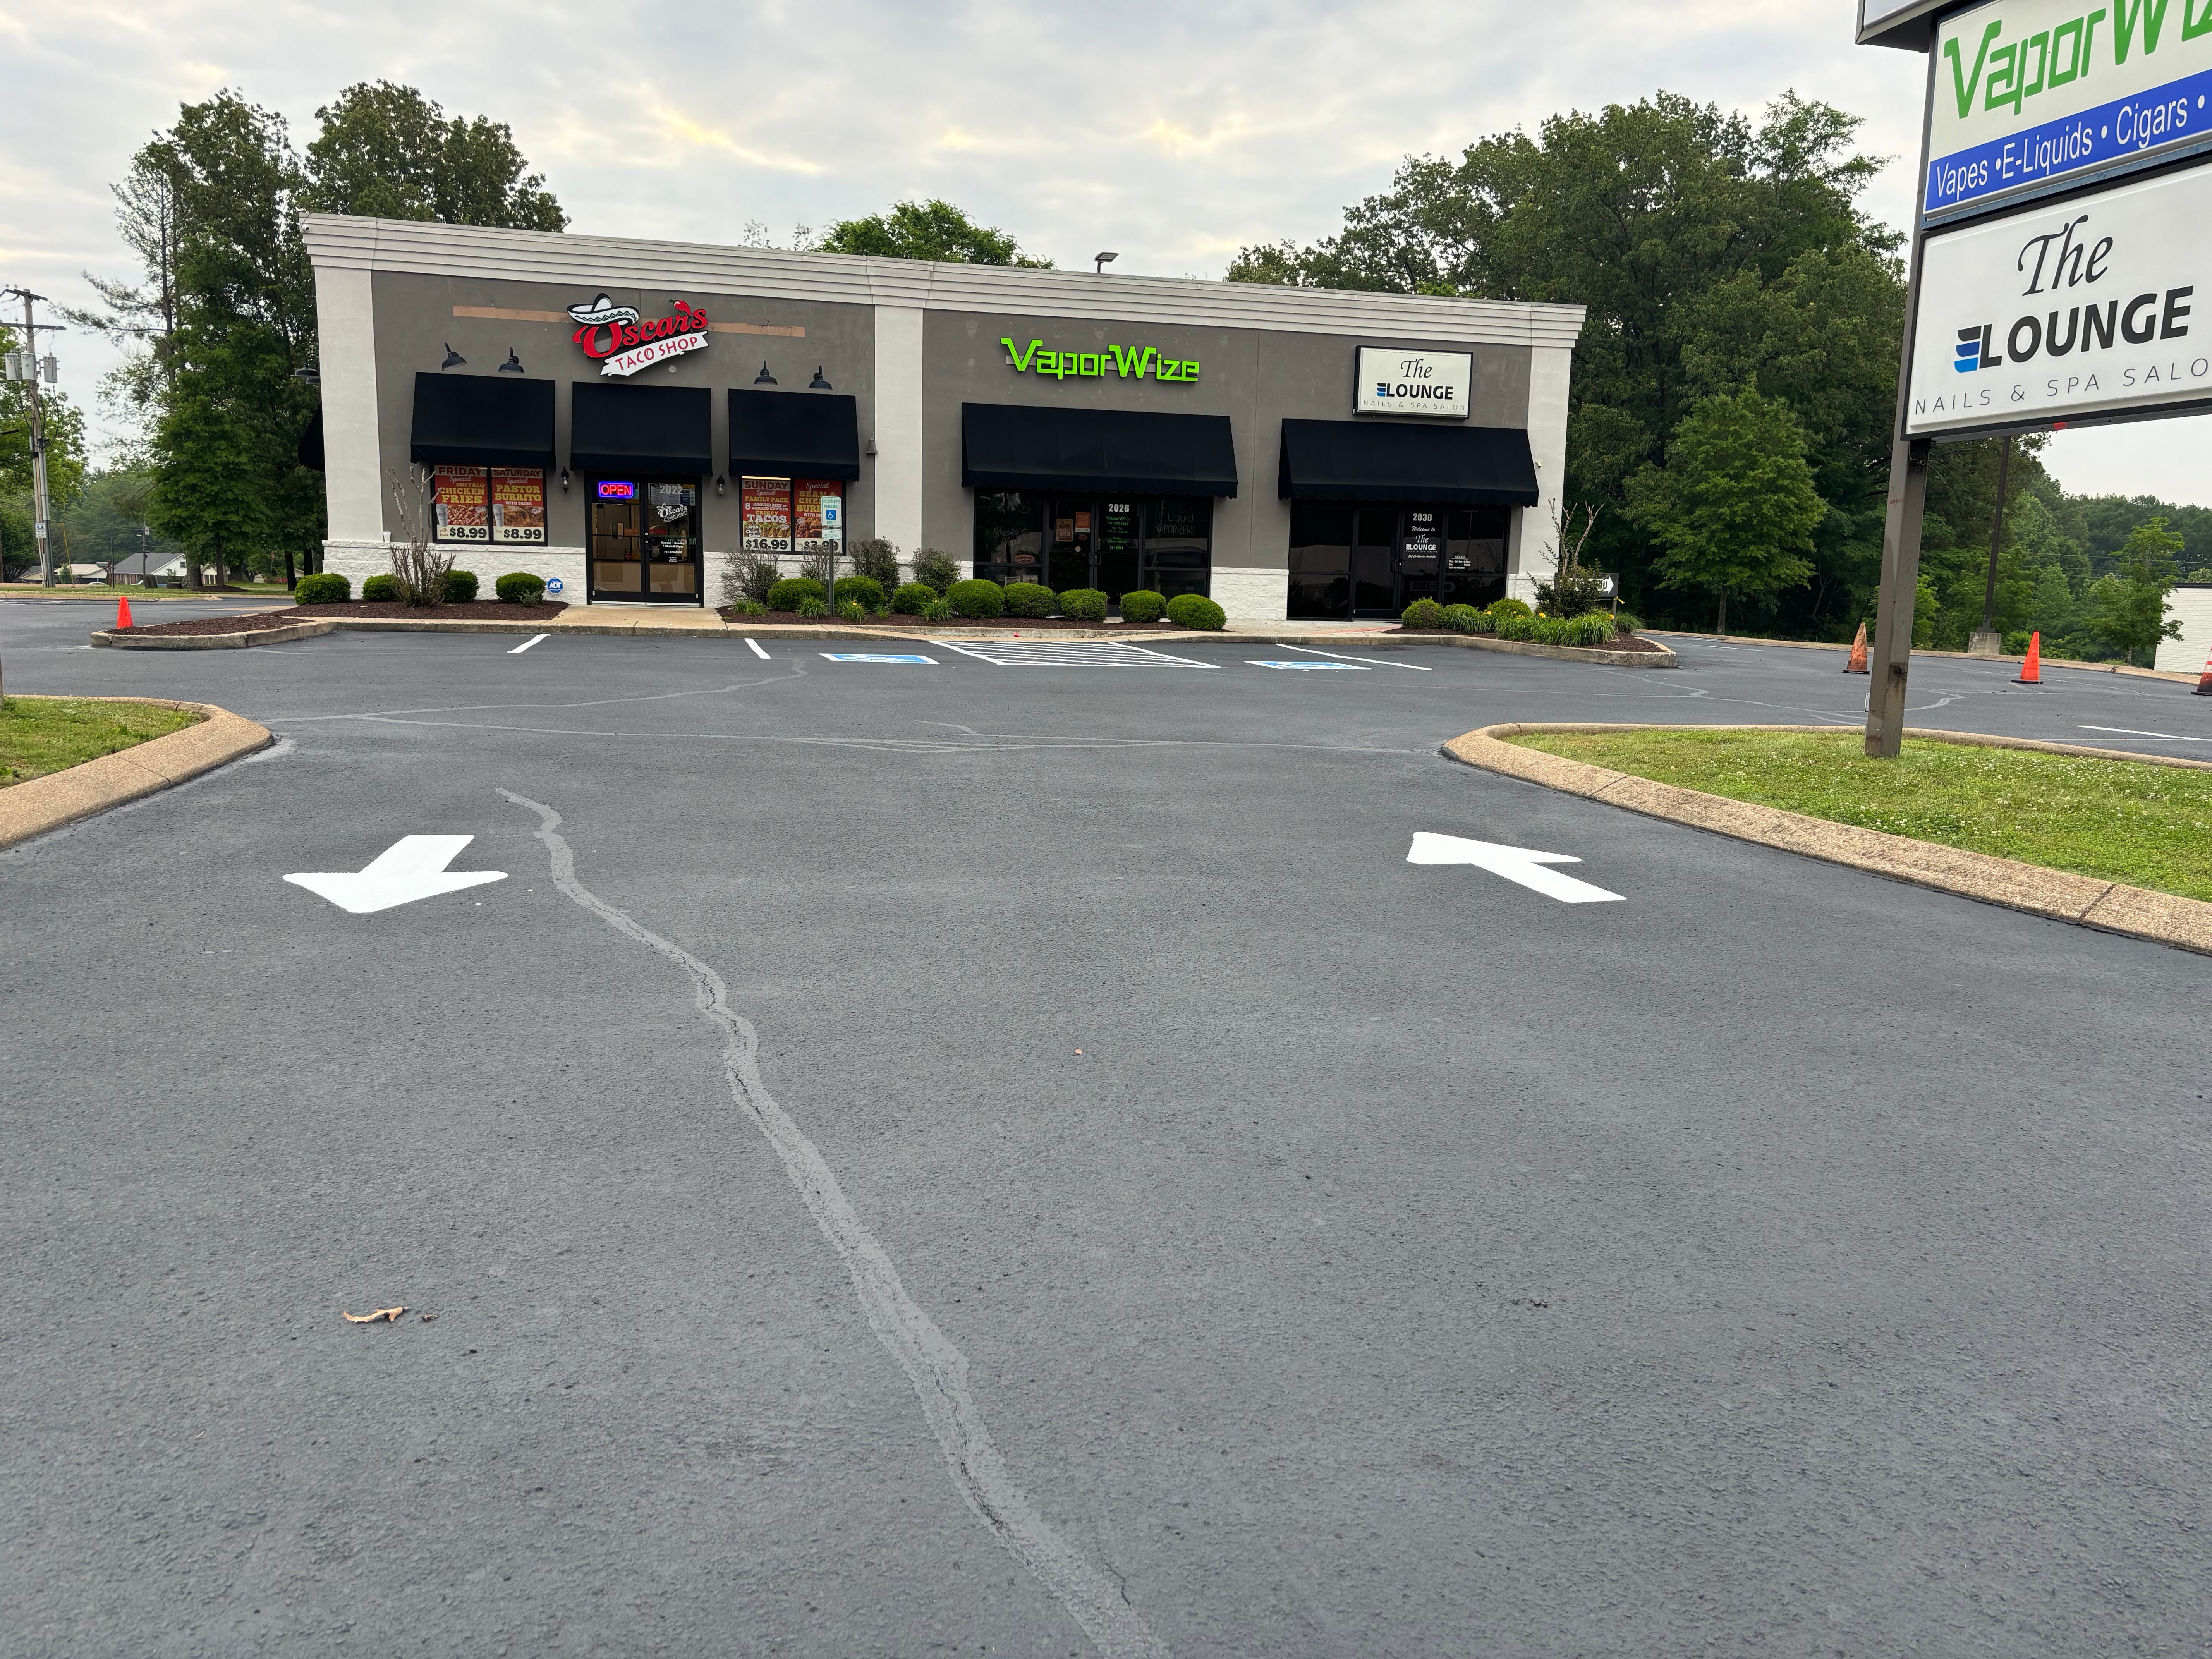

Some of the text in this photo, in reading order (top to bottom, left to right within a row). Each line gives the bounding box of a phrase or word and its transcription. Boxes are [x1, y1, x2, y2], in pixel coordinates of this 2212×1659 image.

[1937, 97, 2188, 201] Vapes E-Liquids Cigars
[2017, 214, 2113, 297] The
[572, 300, 708, 358] Oscar's
[1979, 285, 2194, 369] LOUNGE
[615, 337, 697, 371] TACO SHOP
[1400, 358, 1432, 378] The
[1386, 383, 1454, 400] LOUNGE
[1915, 389, 1991, 415] NAILS
[2011, 385, 2025, 402] &
[2046, 374, 2099, 397] SPA
[438, 467, 482, 476] FRIDAY
[494, 469, 541, 477] SATURDAY
[449, 476, 472, 484] Special
[507, 477, 528, 485] Special
[745, 481, 788, 490] SUNDAY
[496, 484, 541, 493] PASTOR
[601, 484, 632, 496] OPEN
[659, 485, 683, 495] 2022
[806, 482, 830, 491] Special
[442, 495, 483, 504] FRIES
[495, 493, 542, 501] BURRITO
[1108, 503, 1130, 513] 2026
[747, 514, 787, 524] TACOS
[1412, 513, 1432, 522] 2030
[450, 527, 487, 538] $8.99
[503, 528, 542, 539] $8.99
[994, 526, 1020, 539] Smoke
[1156, 523, 1195, 535] VAPORIZERS
[1000, 536, 1021, 549] Vape
[1415, 534, 1429, 543] The
[746, 539, 788, 550] $16.99
